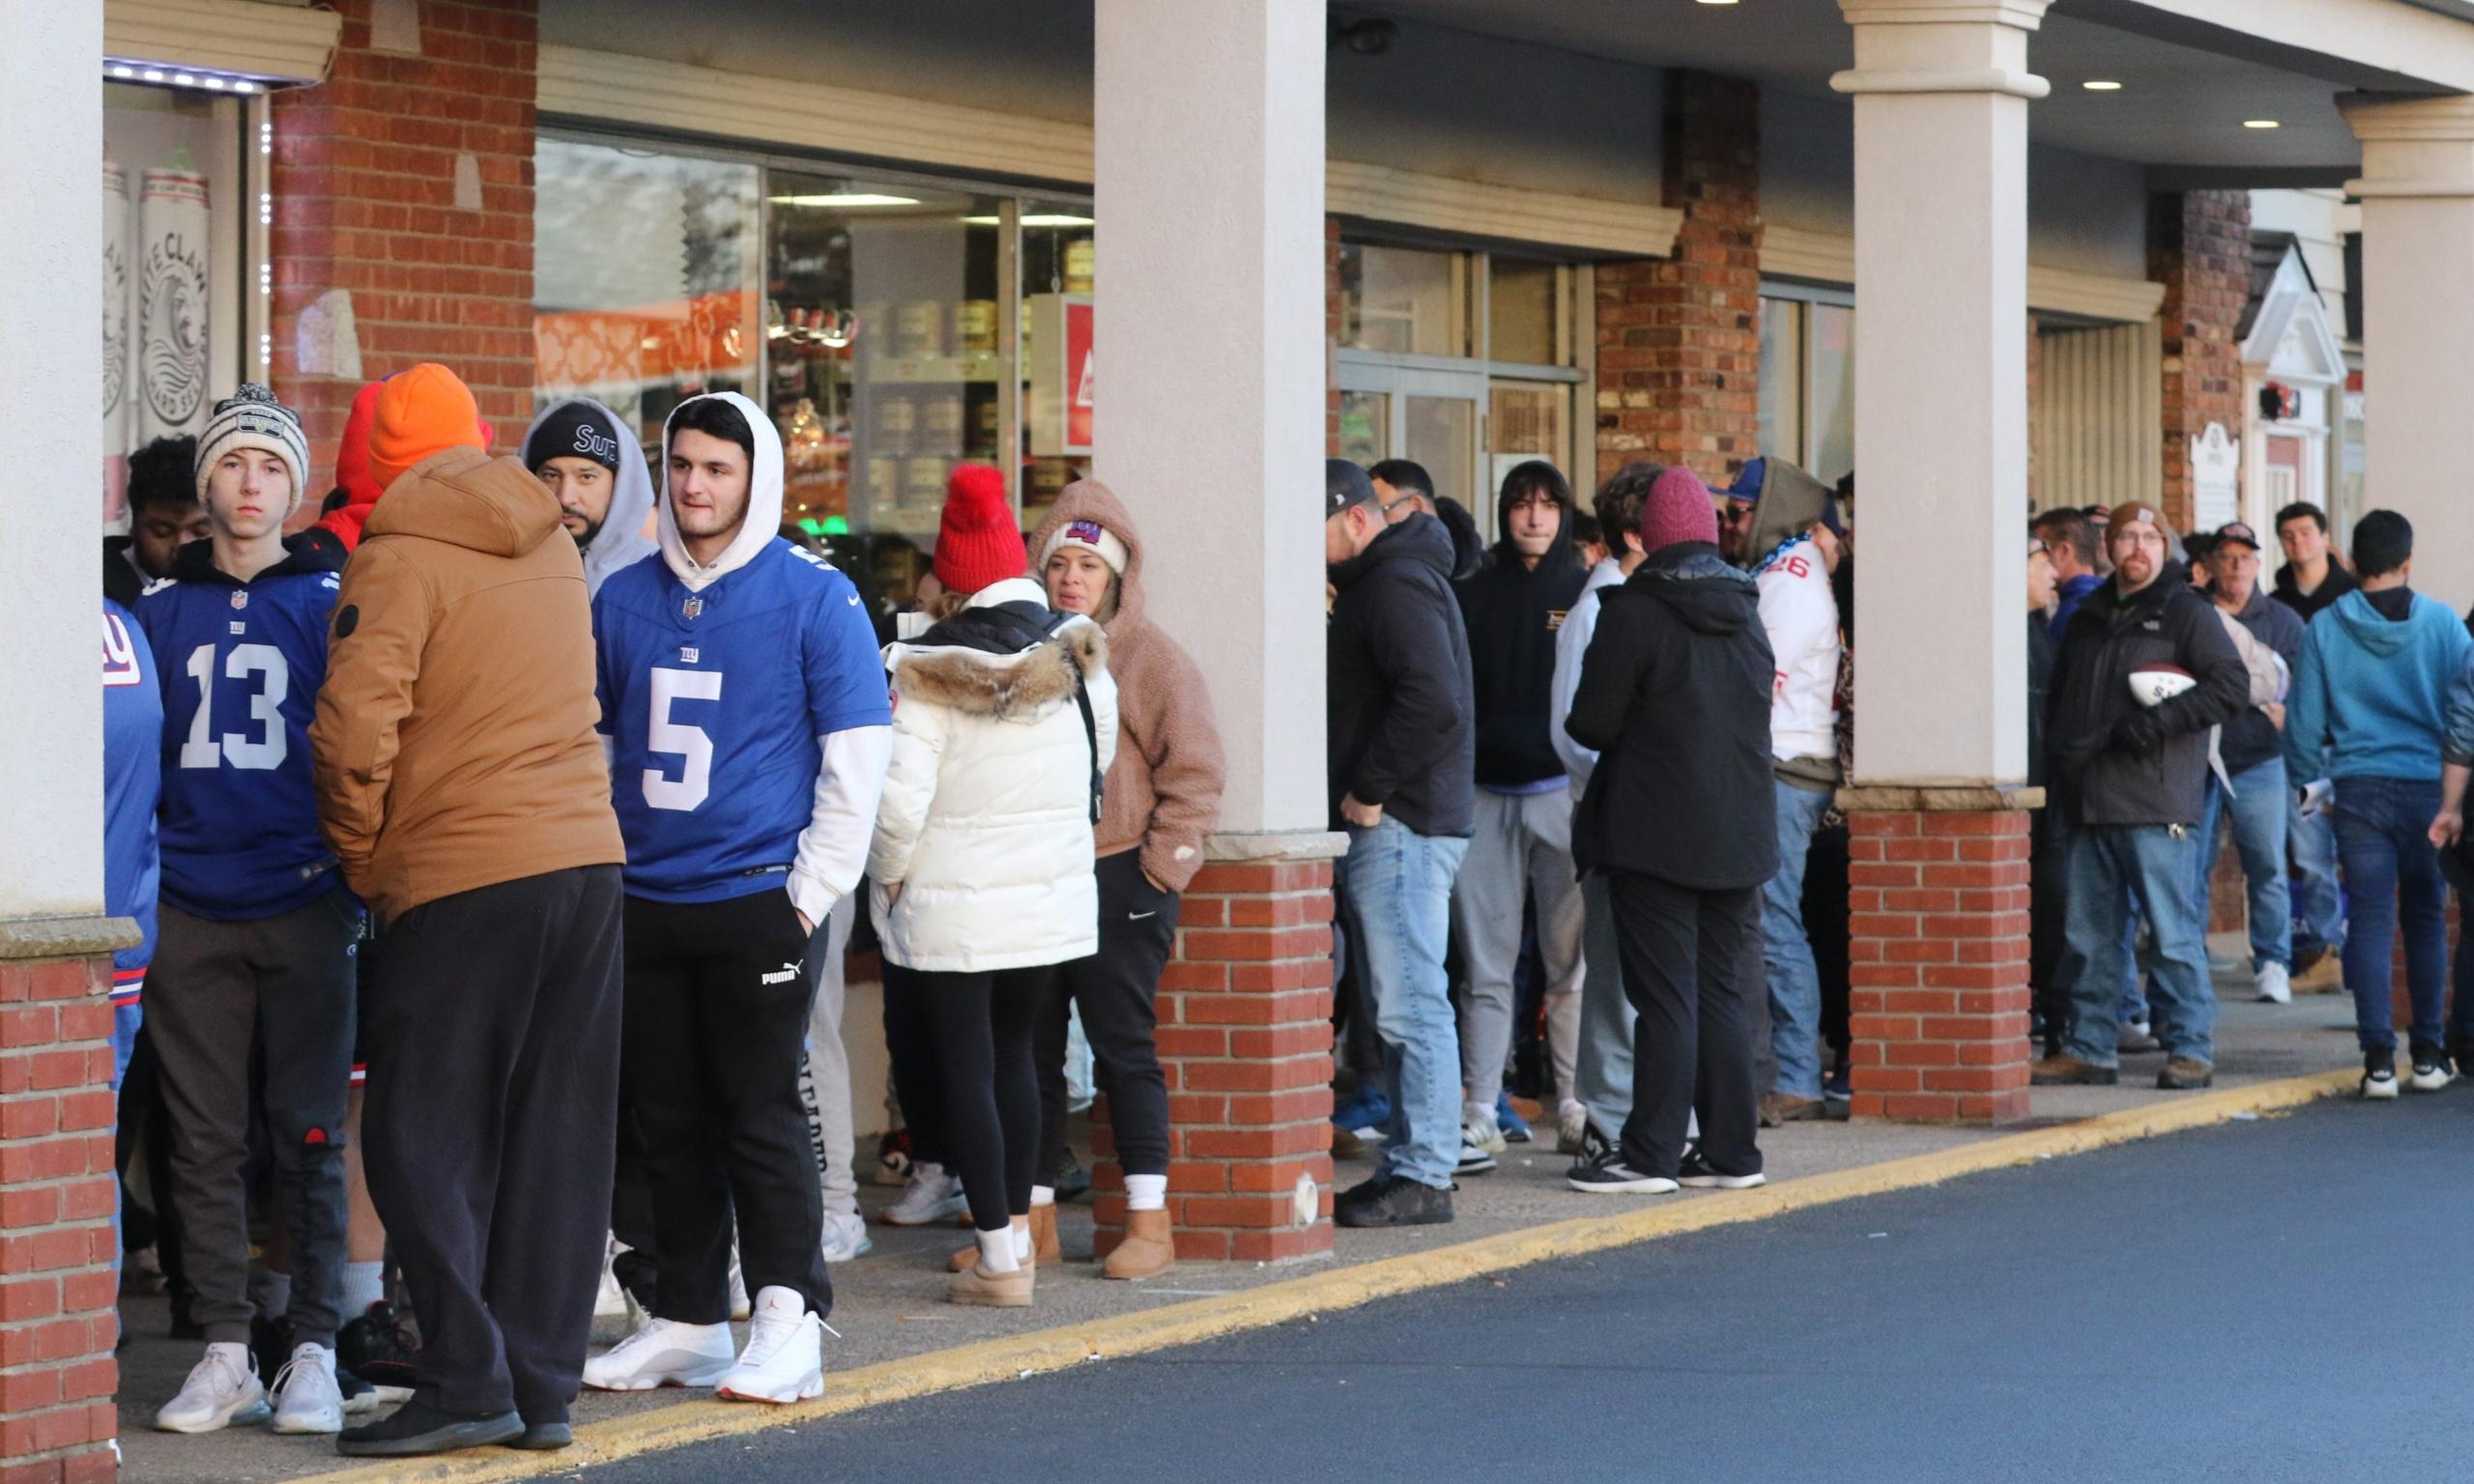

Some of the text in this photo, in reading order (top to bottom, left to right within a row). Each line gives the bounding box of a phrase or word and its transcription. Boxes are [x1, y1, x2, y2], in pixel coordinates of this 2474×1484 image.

[165, 232, 207, 294] CLAW
[180, 642, 289, 770] 13
[642, 667, 723, 812] 5
